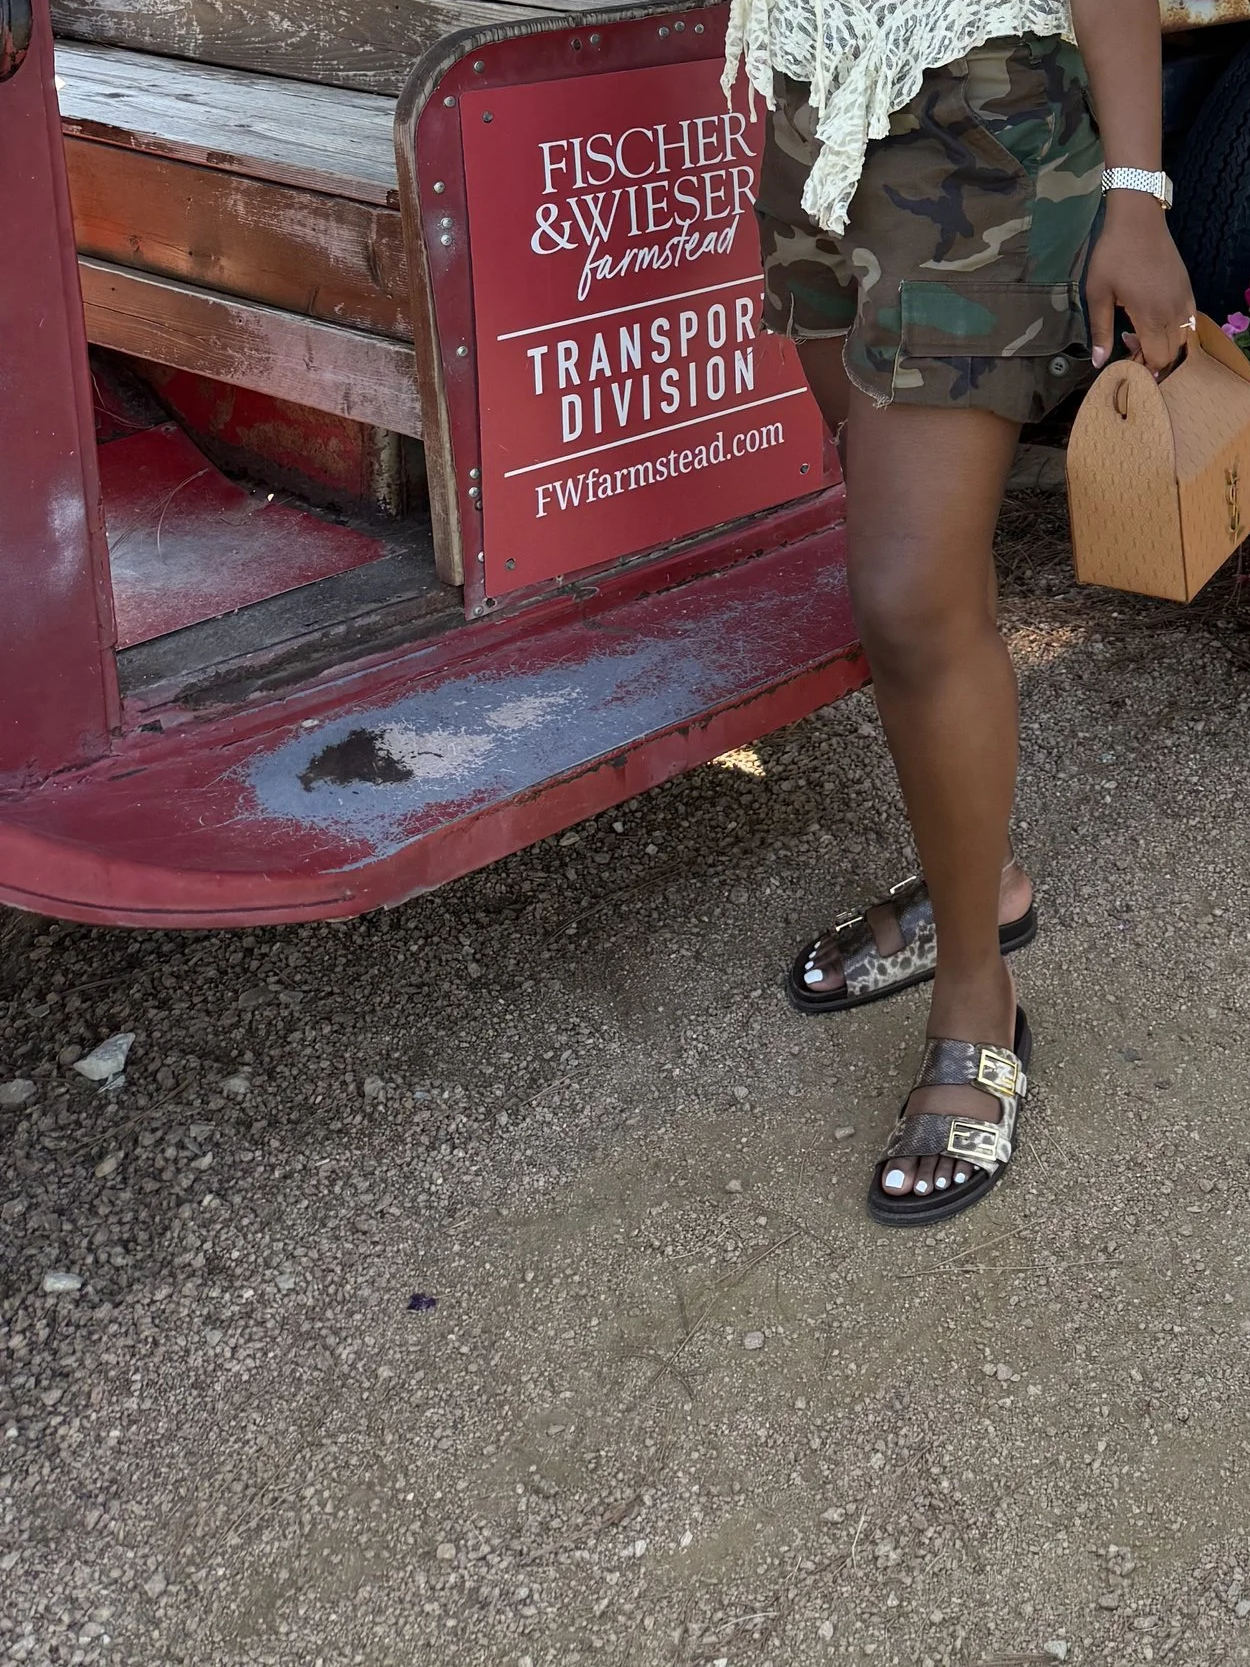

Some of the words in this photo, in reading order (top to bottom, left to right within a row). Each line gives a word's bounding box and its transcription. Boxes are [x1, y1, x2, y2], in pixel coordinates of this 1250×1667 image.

[538, 111, 757, 195] FISCHER
[577, 214, 740, 302] farmstead
[526, 292, 764, 395] TRANSPOR
[561, 347, 755, 443] DIVISION
[534, 421, 785, 518] FWfarmstead.com
